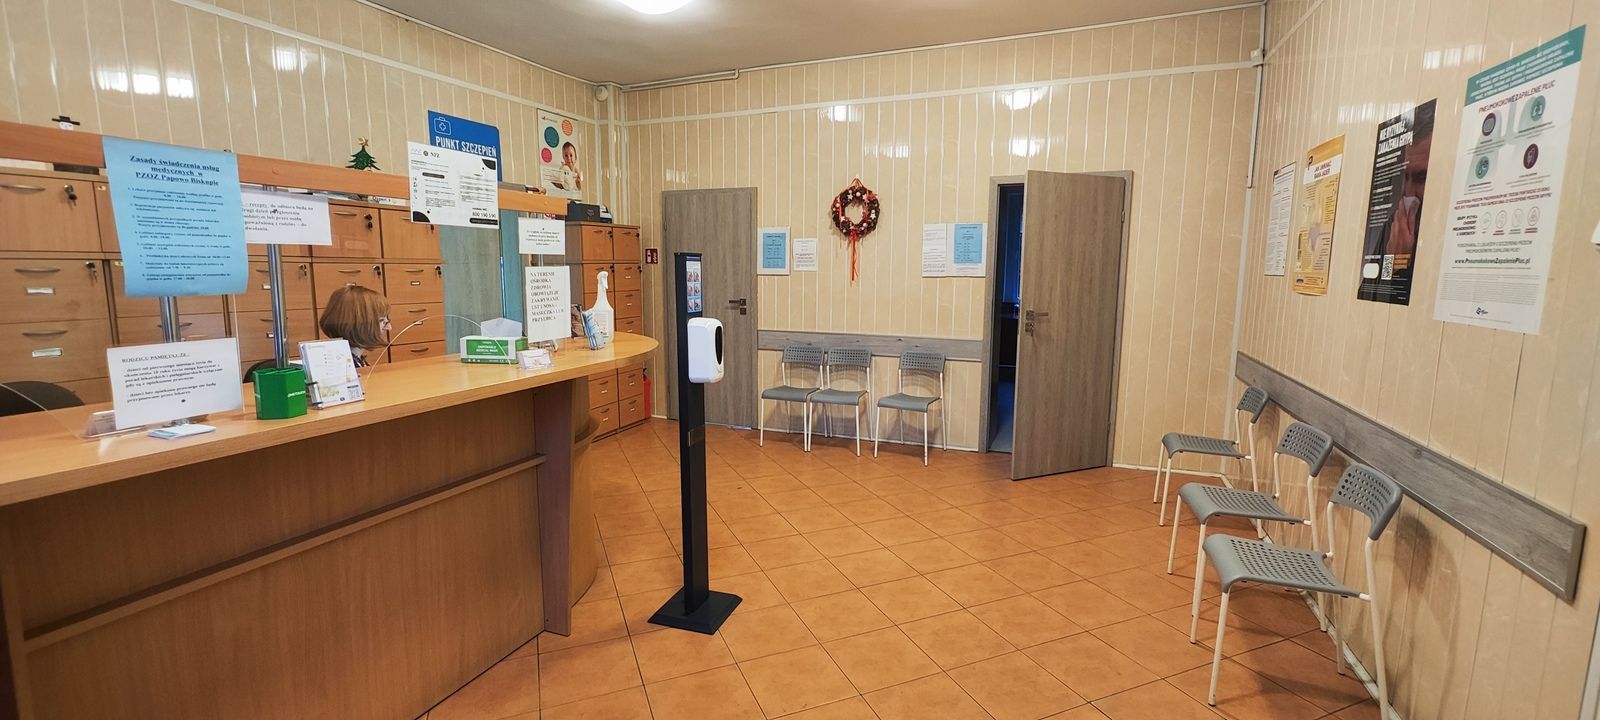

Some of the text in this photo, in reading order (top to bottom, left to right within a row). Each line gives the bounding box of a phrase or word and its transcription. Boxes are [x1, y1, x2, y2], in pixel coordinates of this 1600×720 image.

[435, 136, 497, 157] PUNKT SZCZEPIEŃ
[130, 155, 220, 173] Zasady świadczenia usług
[151, 167, 194, 177] medycznych
[136, 172, 220, 186] PZOZ Papowo Biskupie
